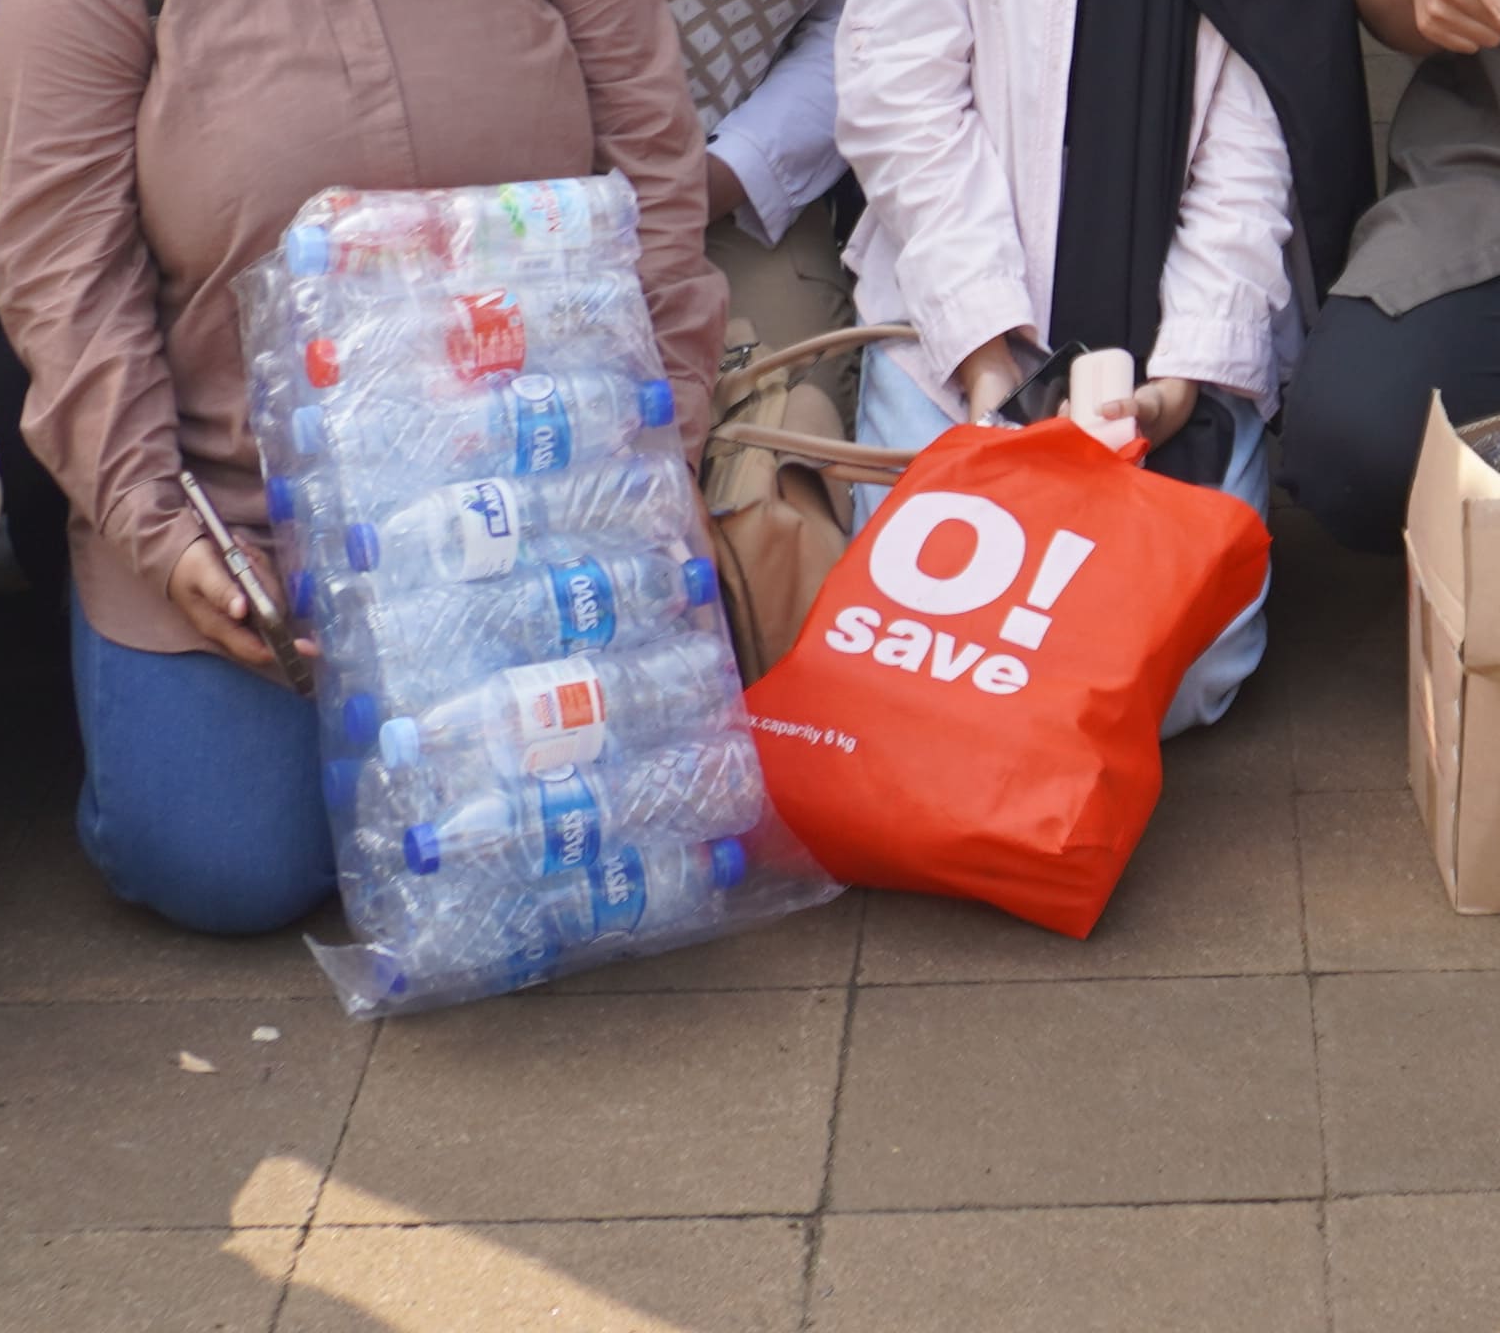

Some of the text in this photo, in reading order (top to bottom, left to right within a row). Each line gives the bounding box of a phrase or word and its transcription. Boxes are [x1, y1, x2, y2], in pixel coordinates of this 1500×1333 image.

[869, 490, 1096, 651] O!
[569, 573, 599, 633] OASIS
[824, 603, 1029, 695] save
[824, 729, 836, 745] 6
[837, 732, 858, 754] kg
[561, 808, 587, 866] OASIS
[603, 852, 630, 907] ASIS
